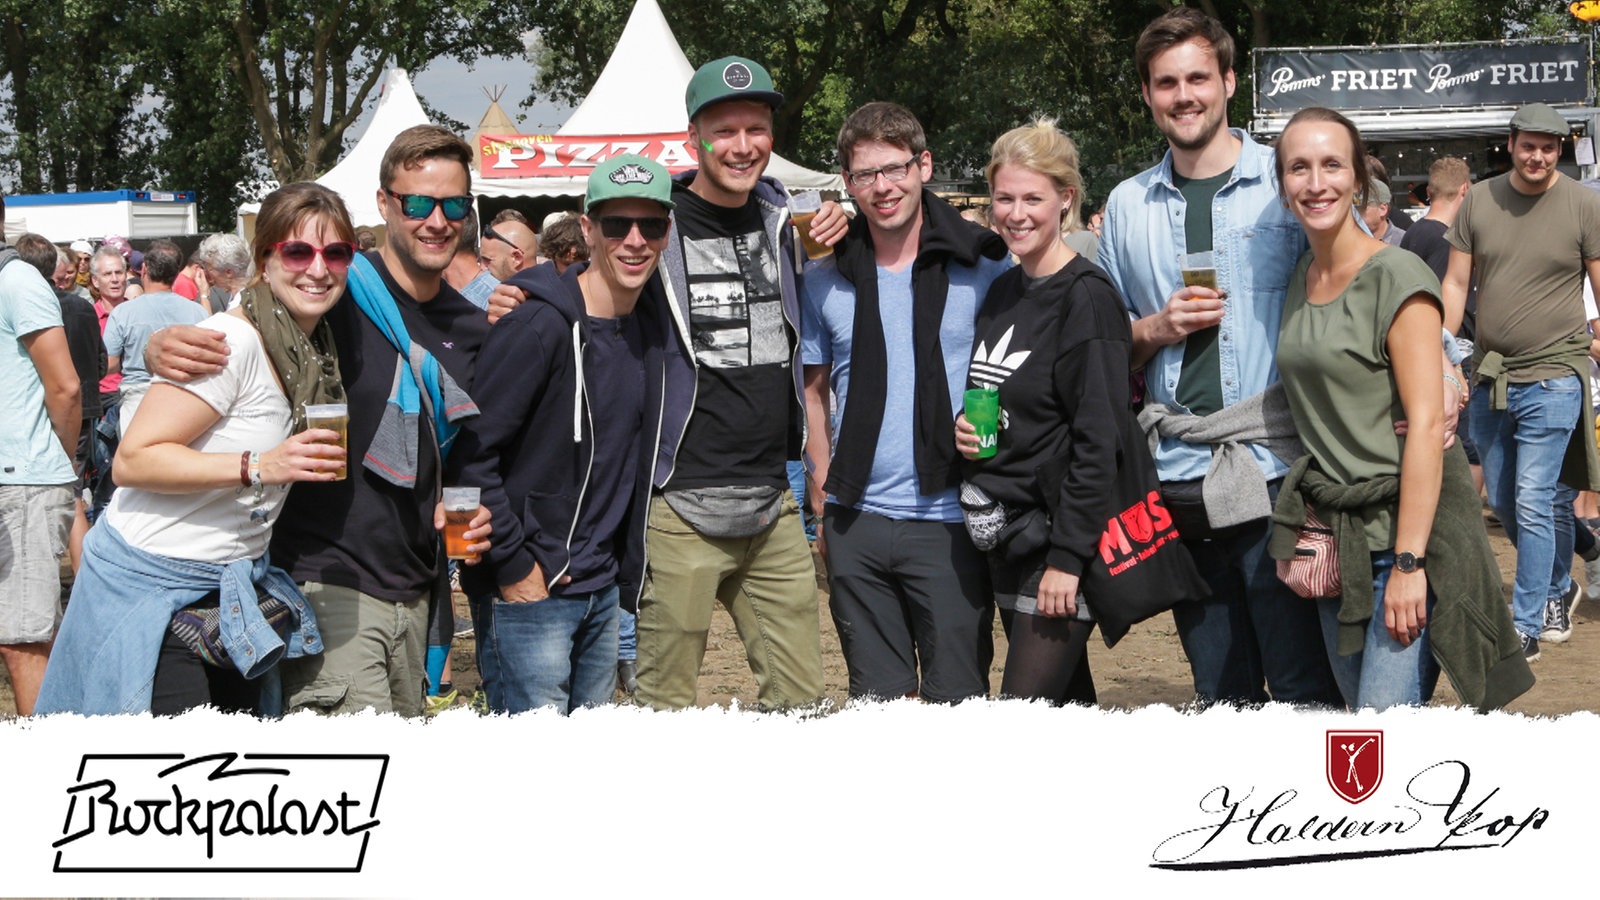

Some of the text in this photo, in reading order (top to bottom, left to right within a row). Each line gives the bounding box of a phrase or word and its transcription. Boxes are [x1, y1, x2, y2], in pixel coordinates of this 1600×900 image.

[1331, 69, 1417, 91] FRIET
[1490, 60, 1578, 85] FRIET
[492, 140, 699, 168] PIZZA
